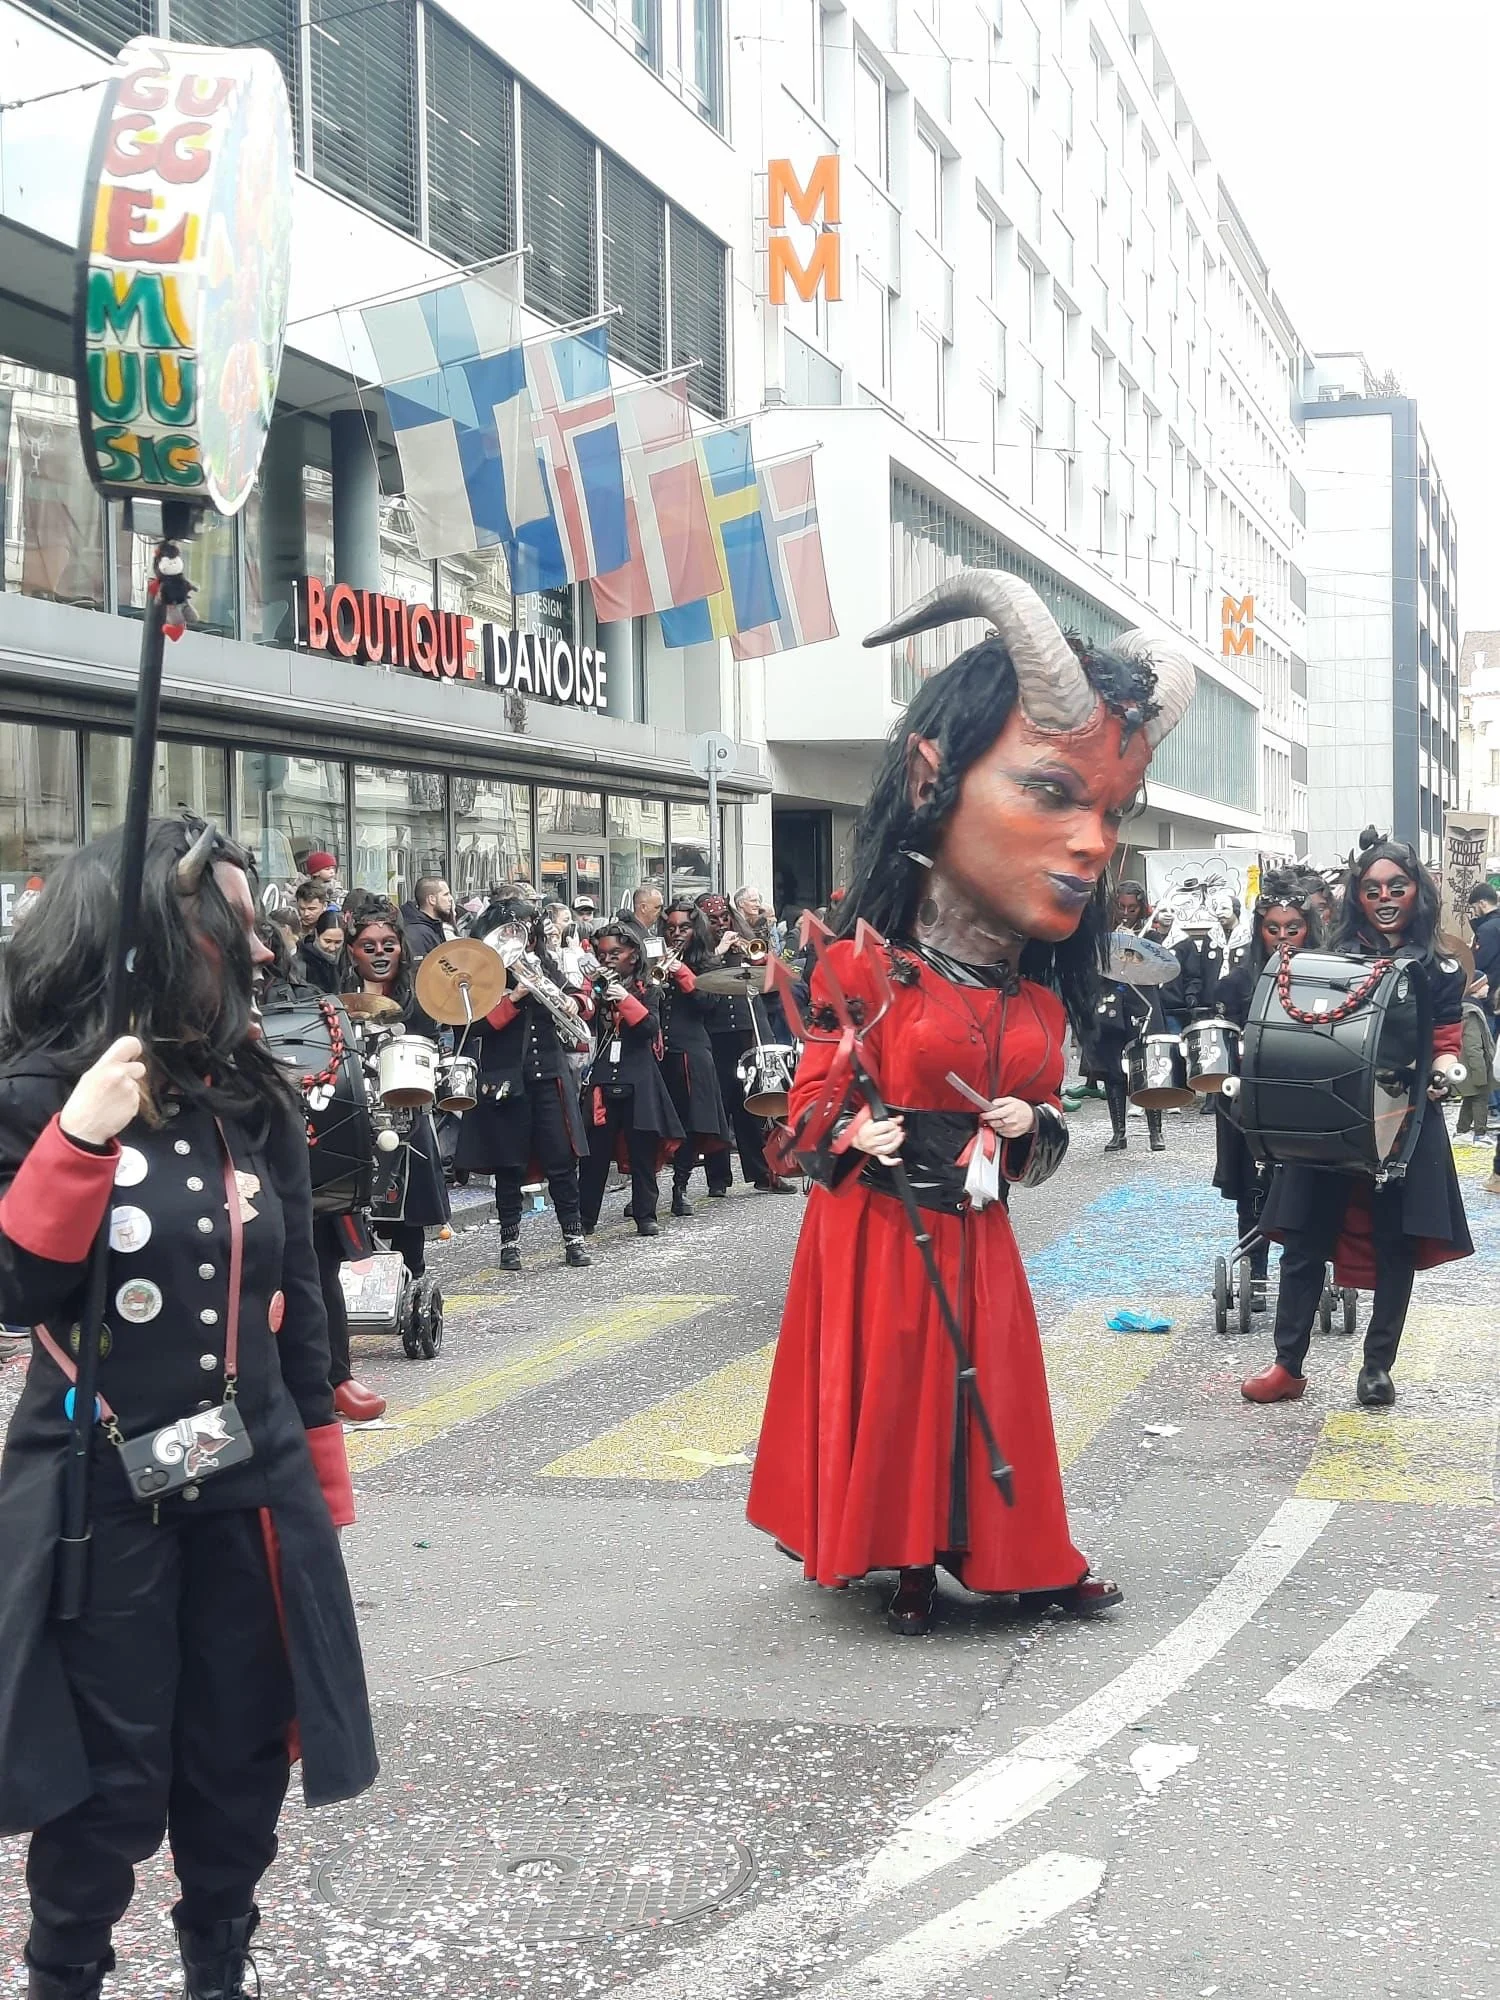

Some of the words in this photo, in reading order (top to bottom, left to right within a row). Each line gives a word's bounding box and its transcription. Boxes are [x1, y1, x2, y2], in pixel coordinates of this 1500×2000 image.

[94, 425, 205, 487] SIG
[531, 593, 563, 620] DESIGN
[307, 575, 477, 680] BOUTIQUE
[492, 622, 608, 708] DANOISE
